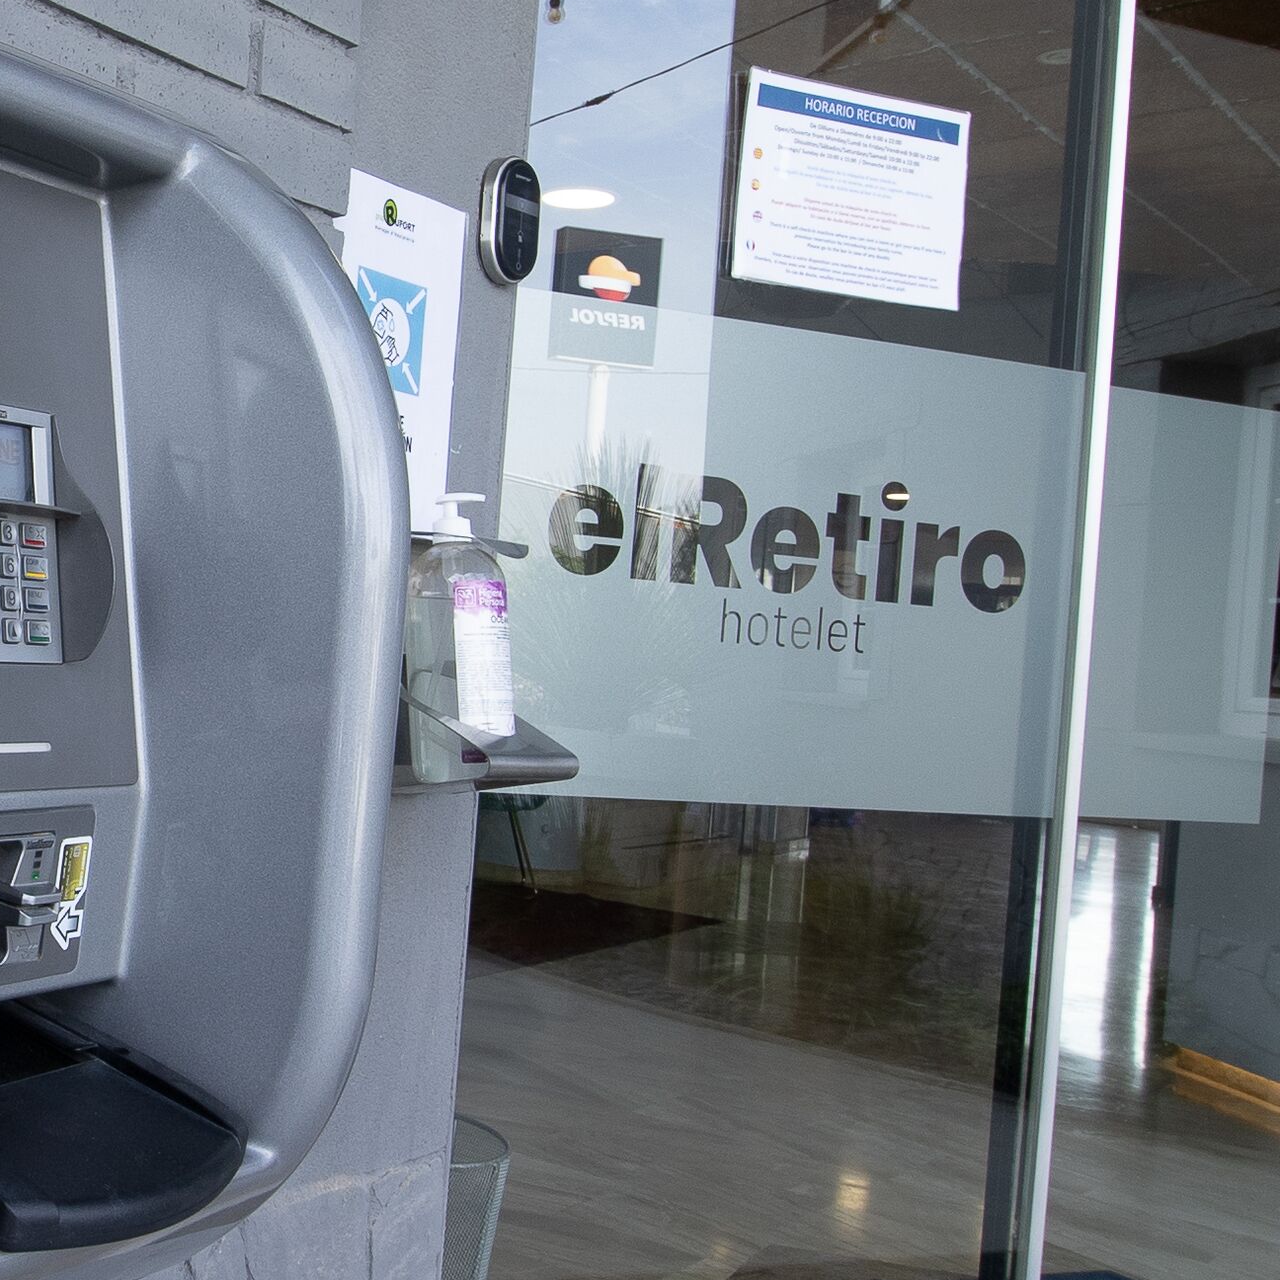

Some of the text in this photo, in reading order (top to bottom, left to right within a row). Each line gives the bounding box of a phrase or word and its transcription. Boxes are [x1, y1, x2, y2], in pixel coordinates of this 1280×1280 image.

[804, 96, 917, 132] HORARIO RECEPCION
[5, 524, 13, 541] 3
[548, 462, 1026, 614] elRetiro
[6, 557, 15, 574] 6
[7, 589, 16, 607] 9
[719, 597, 867, 655] hotelet
